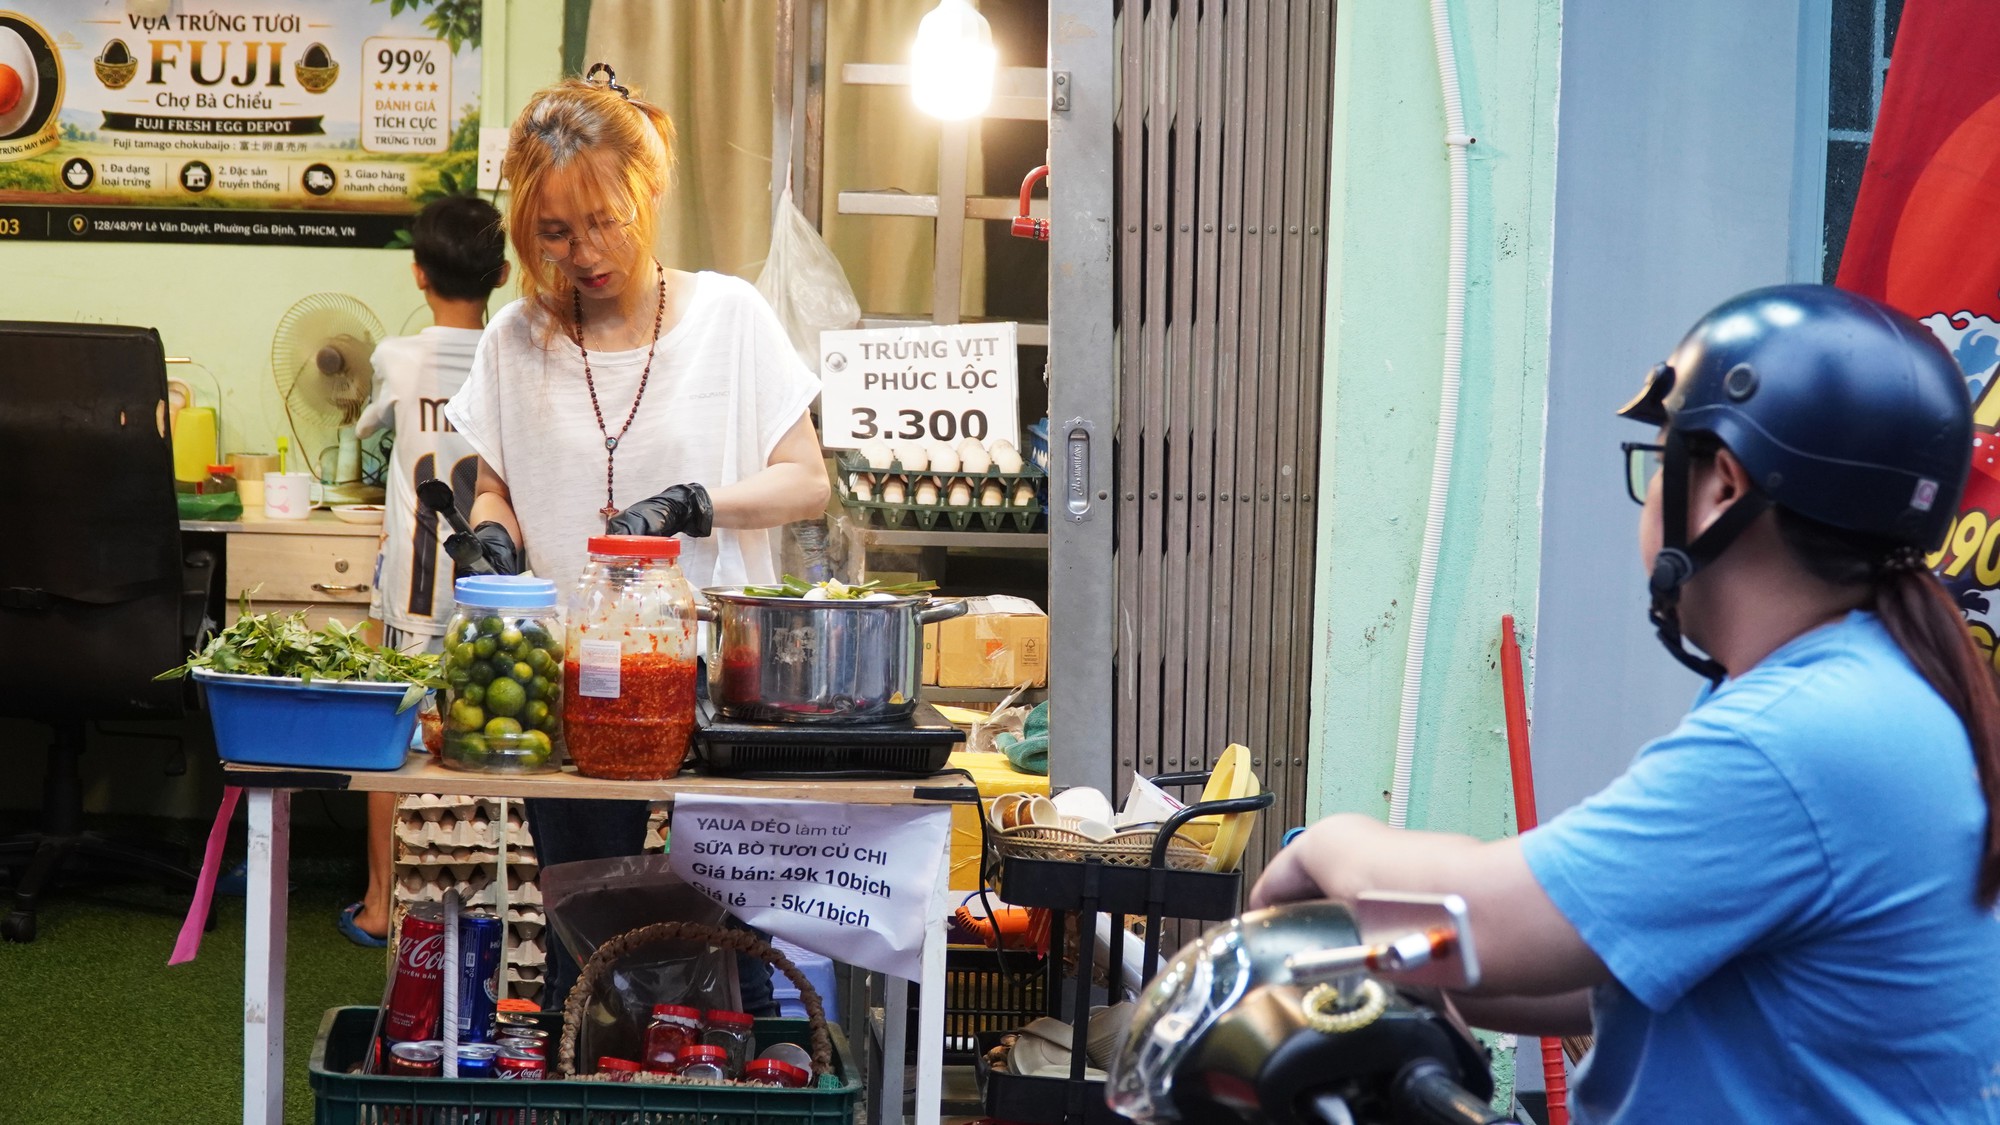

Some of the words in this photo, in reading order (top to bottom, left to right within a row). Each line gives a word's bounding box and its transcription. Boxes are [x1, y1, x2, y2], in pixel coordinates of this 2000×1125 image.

[176, 10, 247, 32] TRỨNG
[252, 14, 300, 33] TƯƠI
[146, 39, 287, 88] FUJI
[377, 48, 435, 75] 99%
[155, 92, 190, 111] Chợ
[196, 92, 217, 109] Bà
[223, 91, 272, 110] Chiểu
[375, 97, 411, 111] ĐÁNH
[414, 99, 436, 112] GIÁ
[135, 118, 164, 130] FUJI
[168, 119, 211, 132] FRESH
[215, 121, 242, 132] EGG
[247, 121, 291, 132] DEPOT
[374, 114, 405, 128] TÍCH
[409, 116, 437, 131] CỰC
[113, 138, 131, 149] Fuji
[134, 140, 172, 150] tamago
[174, 139, 230, 151] chokubaijo
[374, 134, 409, 145] TRỨNG
[413, 136, 436, 146] TƯƠI
[101, 164, 107, 173] 1.
[110, 164, 123, 173] Đa
[126, 164, 150, 176] dạng
[218, 167, 227, 175] 2.
[344, 170, 353, 178] 3.
[355, 170, 378, 179] Giao
[381, 170, 405, 182] hàng
[101, 177, 119, 187] loại
[122, 176, 151, 188] trứng
[344, 183, 375, 192] nhanh
[377, 184, 407, 195] chóng
[94, 221, 142, 231] 128/48/9Y
[145, 221, 158, 232] Lê
[160, 221, 178, 232] Văn
[253, 224, 269, 234] Gia
[340, 227, 356, 236] VN
[859, 337, 948, 360] TRỨNG
[957, 337, 999, 361] VỊT
[864, 366, 937, 390] PHÚC
[946, 364, 998, 394] LỘC
[851, 407, 988, 442] 3.300
[697, 818, 746, 831] YAUA
[796, 823, 827, 836] làm
[832, 824, 851, 836] từ
[693, 840, 733, 855] SỮA
[738, 841, 764, 855] BÒ
[769, 844, 817, 857] TƯƠI
[821, 843, 849, 858] CỦ
[854, 847, 887, 865] CHI
[692, 863, 725, 879] Giá
[731, 866, 775, 880] bán:
[780, 867, 819, 882] 49k
[825, 869, 891, 898] 10bịch
[781, 894, 870, 927] 5k/1bịch
